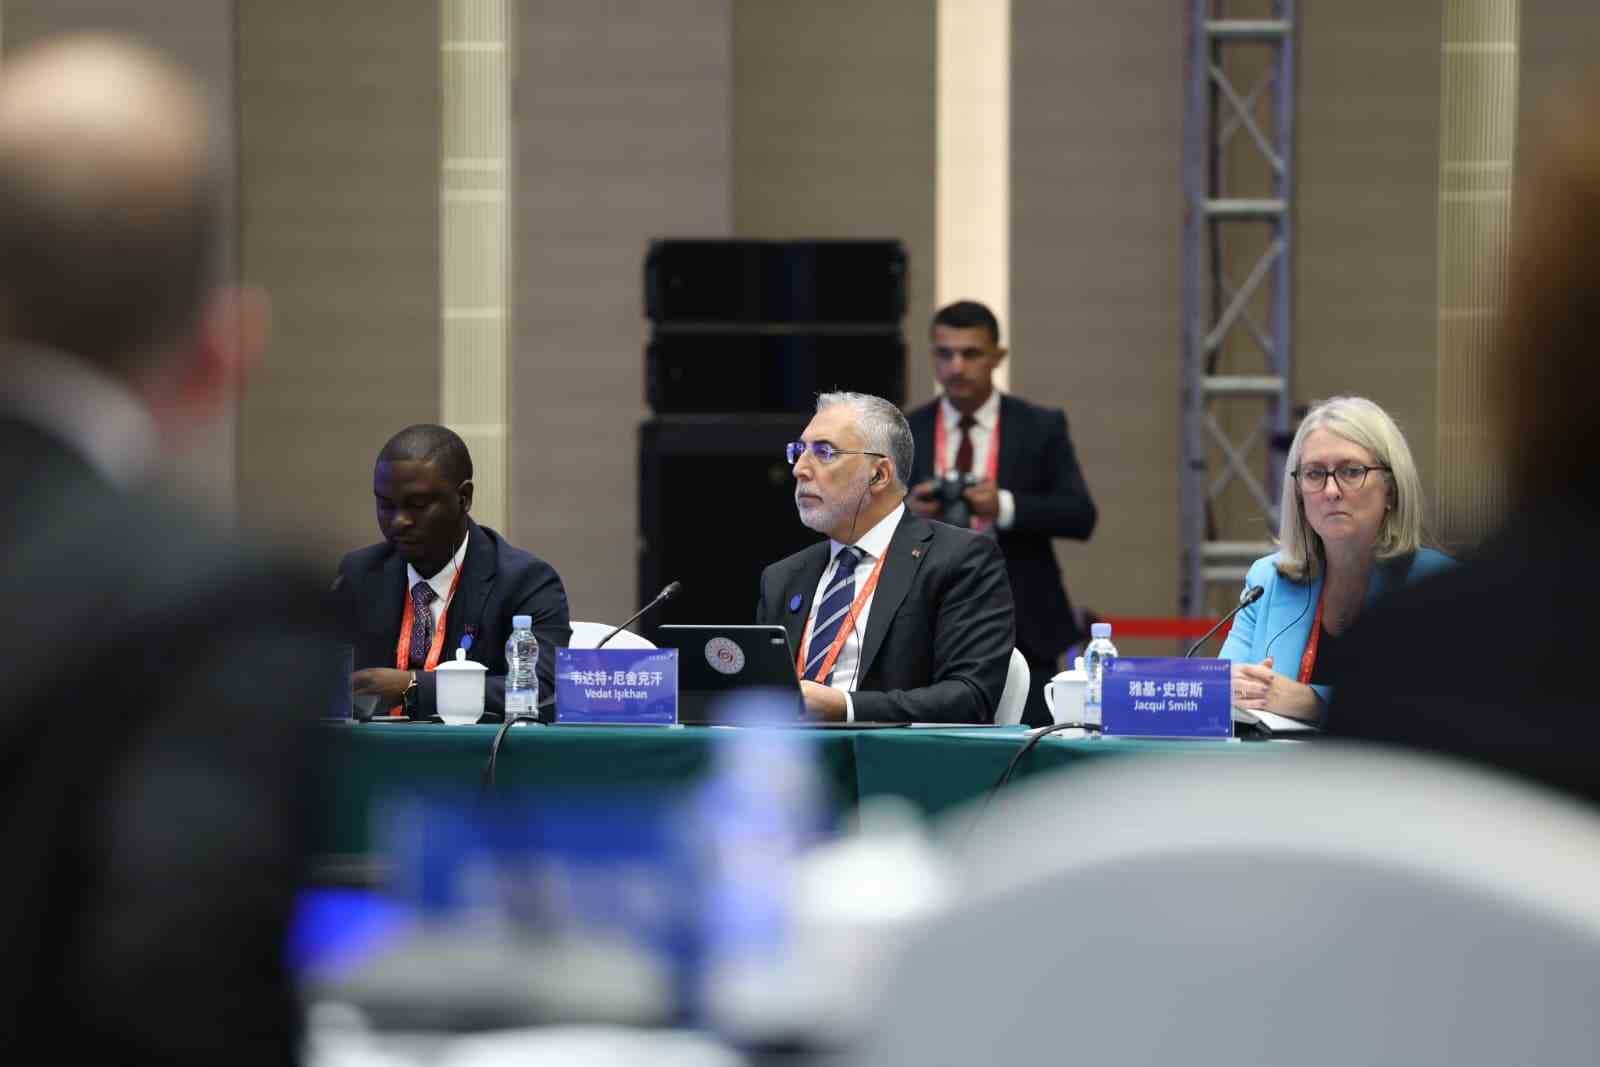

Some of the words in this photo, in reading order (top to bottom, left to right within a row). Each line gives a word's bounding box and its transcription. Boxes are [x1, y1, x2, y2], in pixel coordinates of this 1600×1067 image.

[585, 688, 612, 699] Vedat
[1133, 700, 1166, 712] Jacqui
[1167, 700, 1198, 711] Smith
